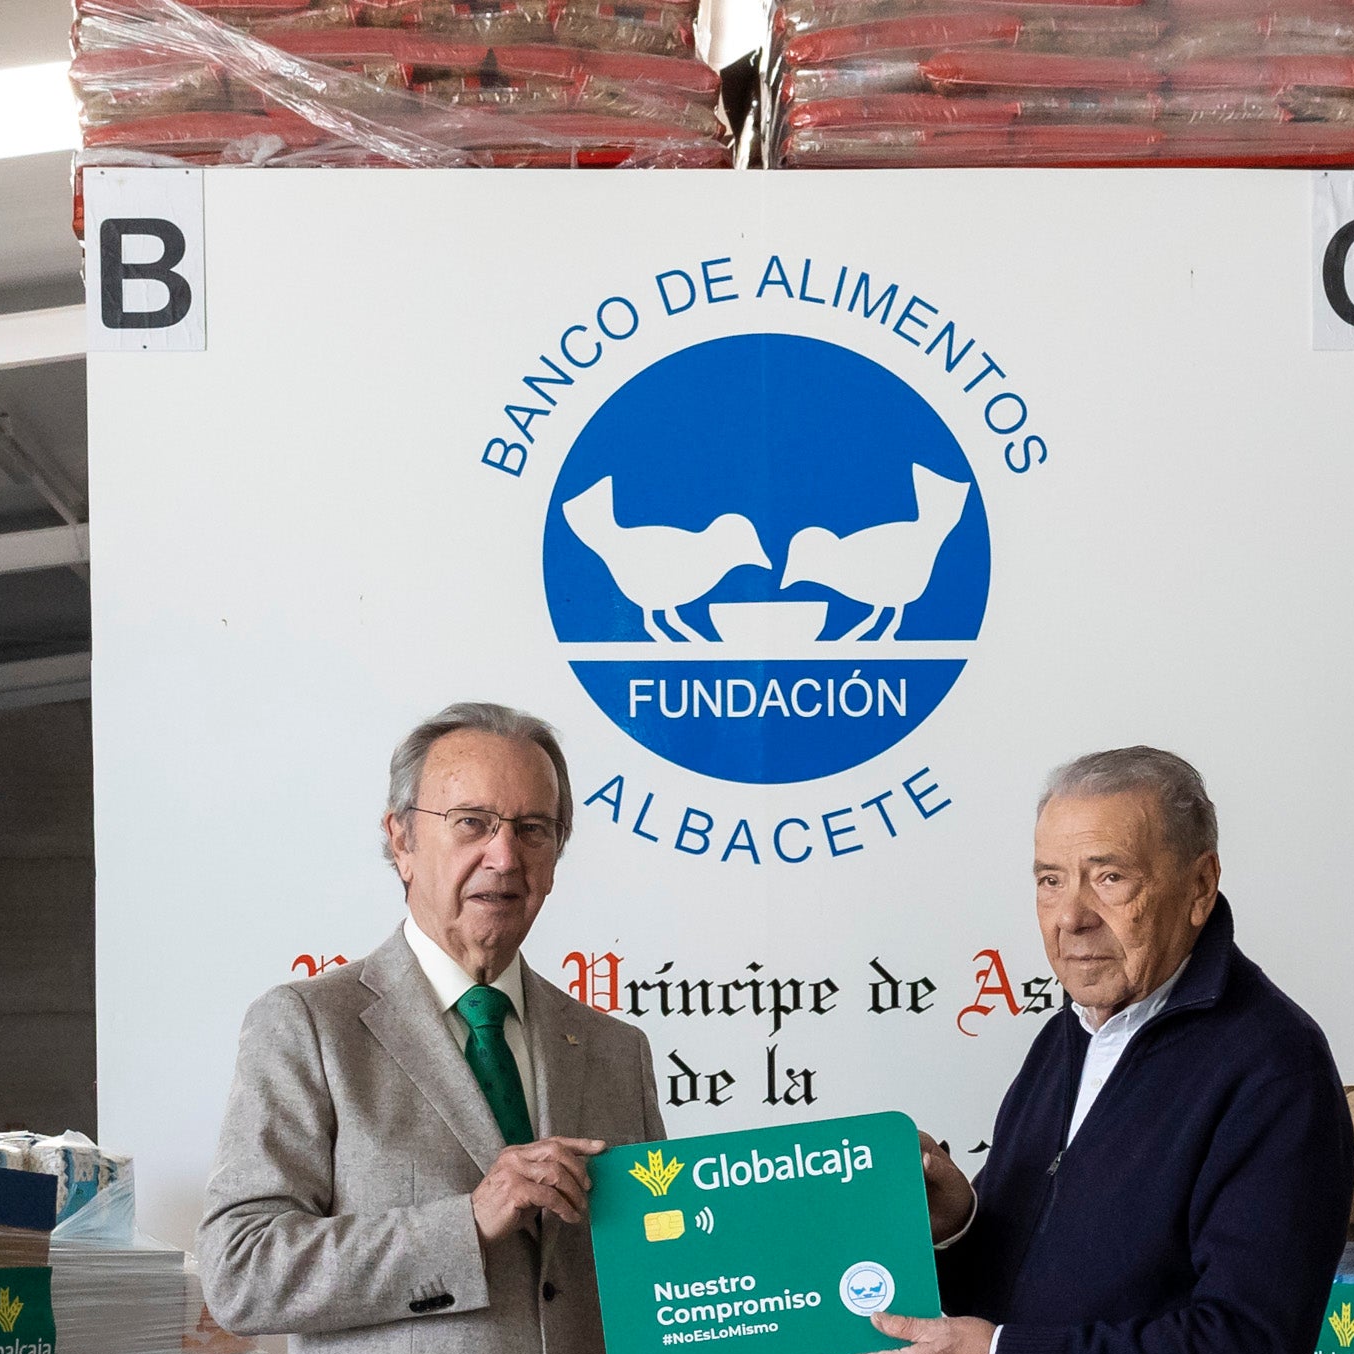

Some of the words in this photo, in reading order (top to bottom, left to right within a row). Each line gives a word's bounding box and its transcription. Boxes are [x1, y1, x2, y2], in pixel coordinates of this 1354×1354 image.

[99, 218, 193, 329] B
[480, 295, 639, 478] BANCO
[655, 256, 738, 317] DE
[756, 254, 1048, 476] ALIMENTOS
[628, 669, 907, 719] FUNDACIÓN
[584, 766, 952, 866] ALBACETE
[562, 950, 839, 1037] Príncipe
[868, 956, 937, 1016] de
[666, 1049, 736, 1107] de
[762, 1043, 817, 1106] la
[692, 1138, 874, 1190] Globalcaja
[653, 1274, 756, 1302] Nuestro
[656, 1289, 822, 1326] Compromiso
[662, 1321, 779, 1346] #NoEsLoMismo
